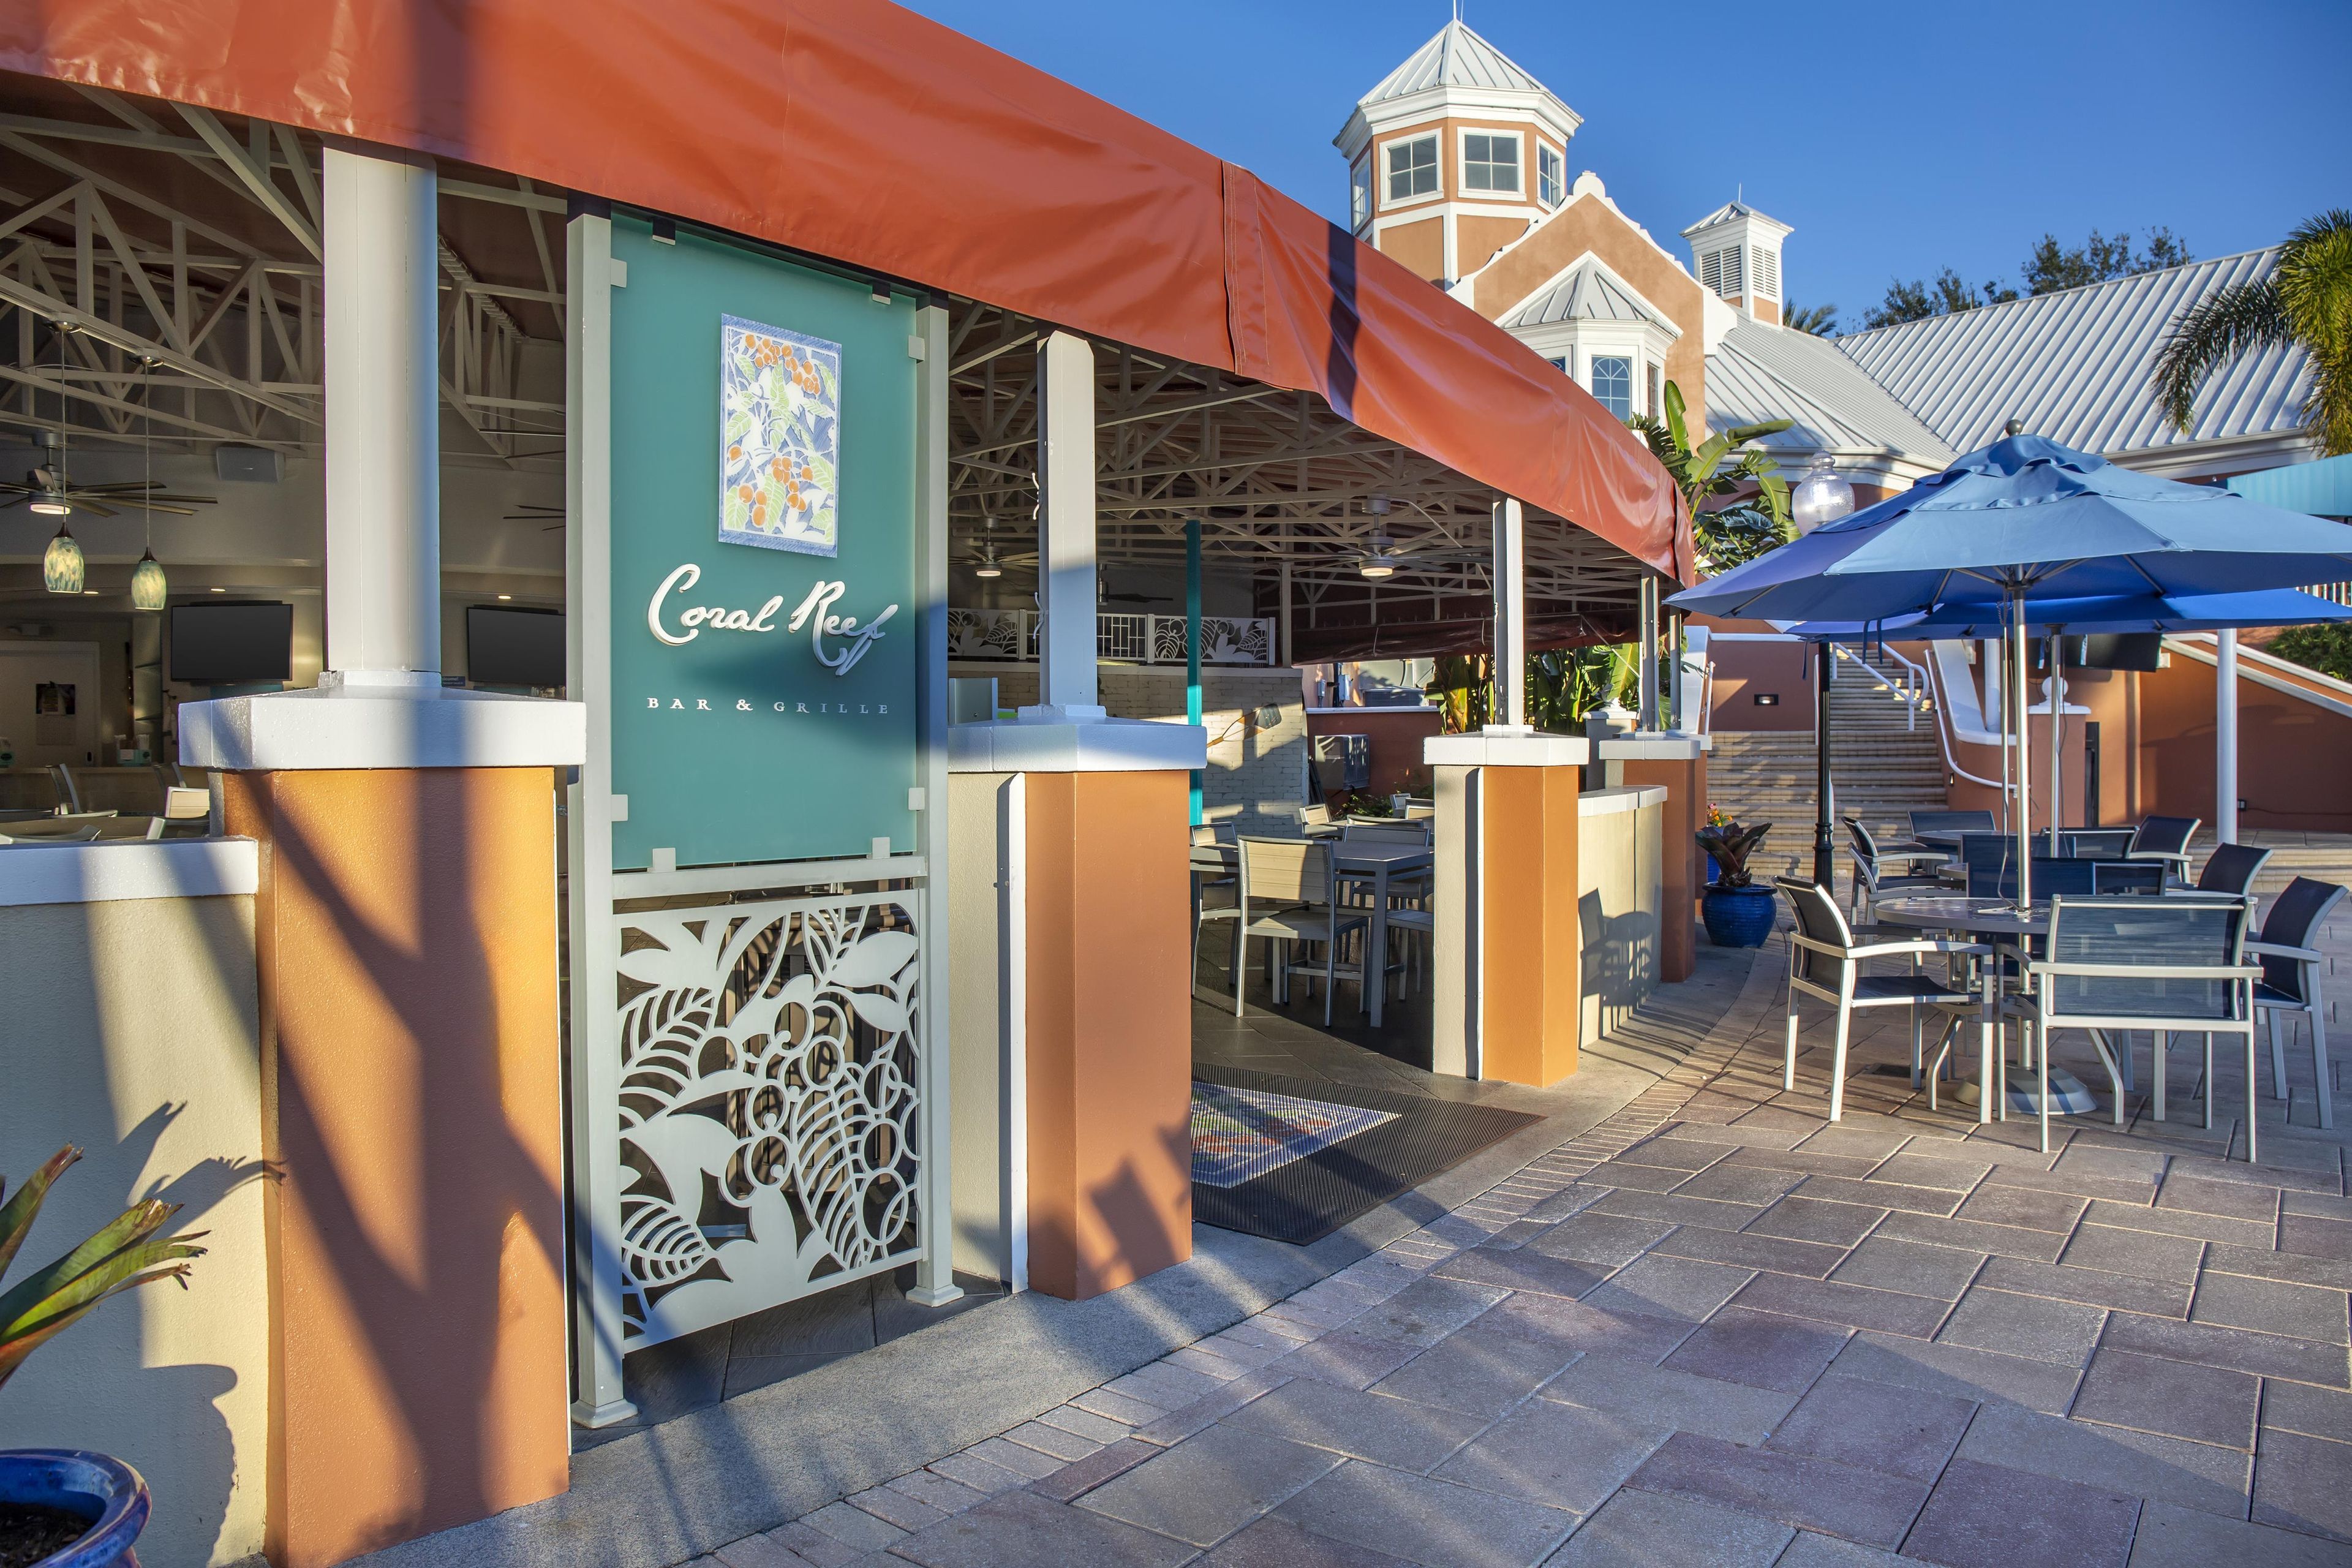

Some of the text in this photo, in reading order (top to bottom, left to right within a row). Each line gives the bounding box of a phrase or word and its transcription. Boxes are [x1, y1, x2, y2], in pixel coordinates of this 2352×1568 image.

[648, 563, 899, 676] Coral Reef
[647, 698, 888, 715] BAR & GRILLE
